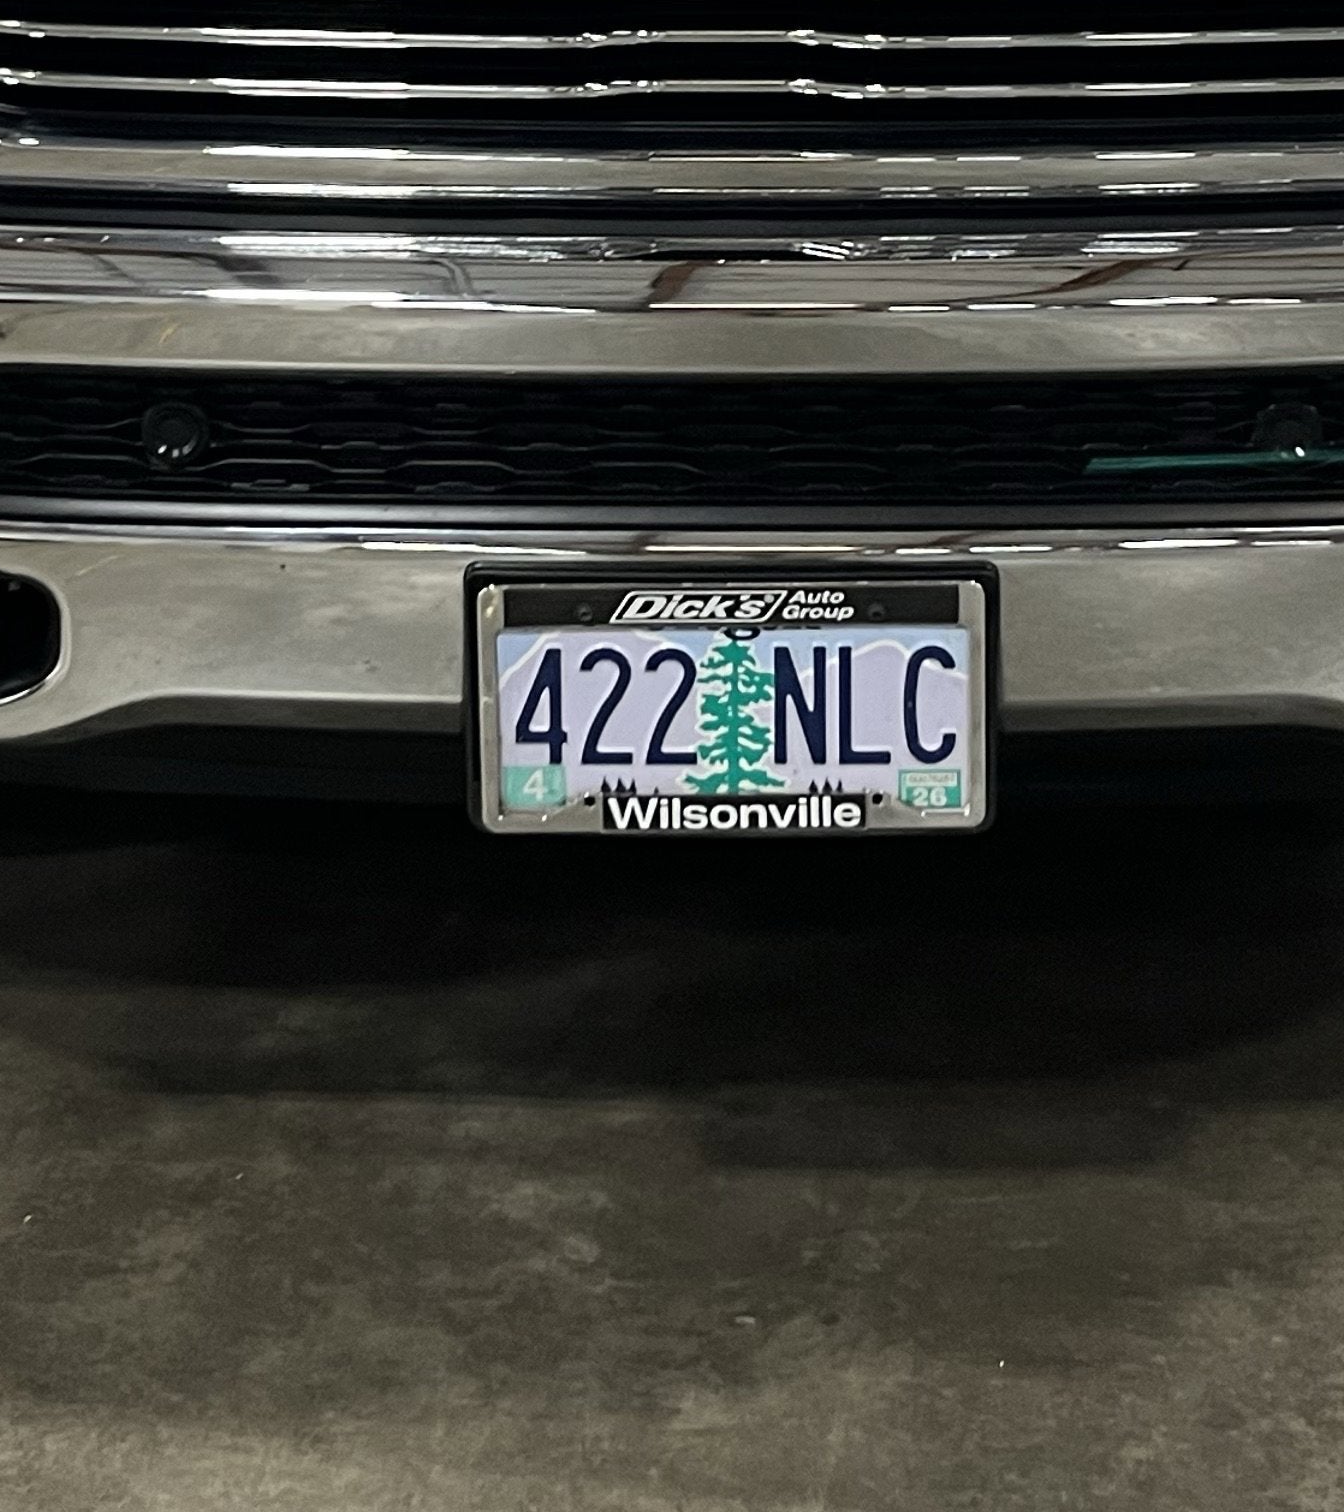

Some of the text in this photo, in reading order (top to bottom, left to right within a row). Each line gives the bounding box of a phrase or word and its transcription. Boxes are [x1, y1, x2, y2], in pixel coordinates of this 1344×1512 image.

[788, 590, 845, 605] Auto
[781, 604, 855, 622] Group
[515, 645, 957, 766] 422 NLC
[522, 767, 549, 802] 4
[911, 786, 948, 807] 26
[607, 795, 862, 830] Wilsonville
